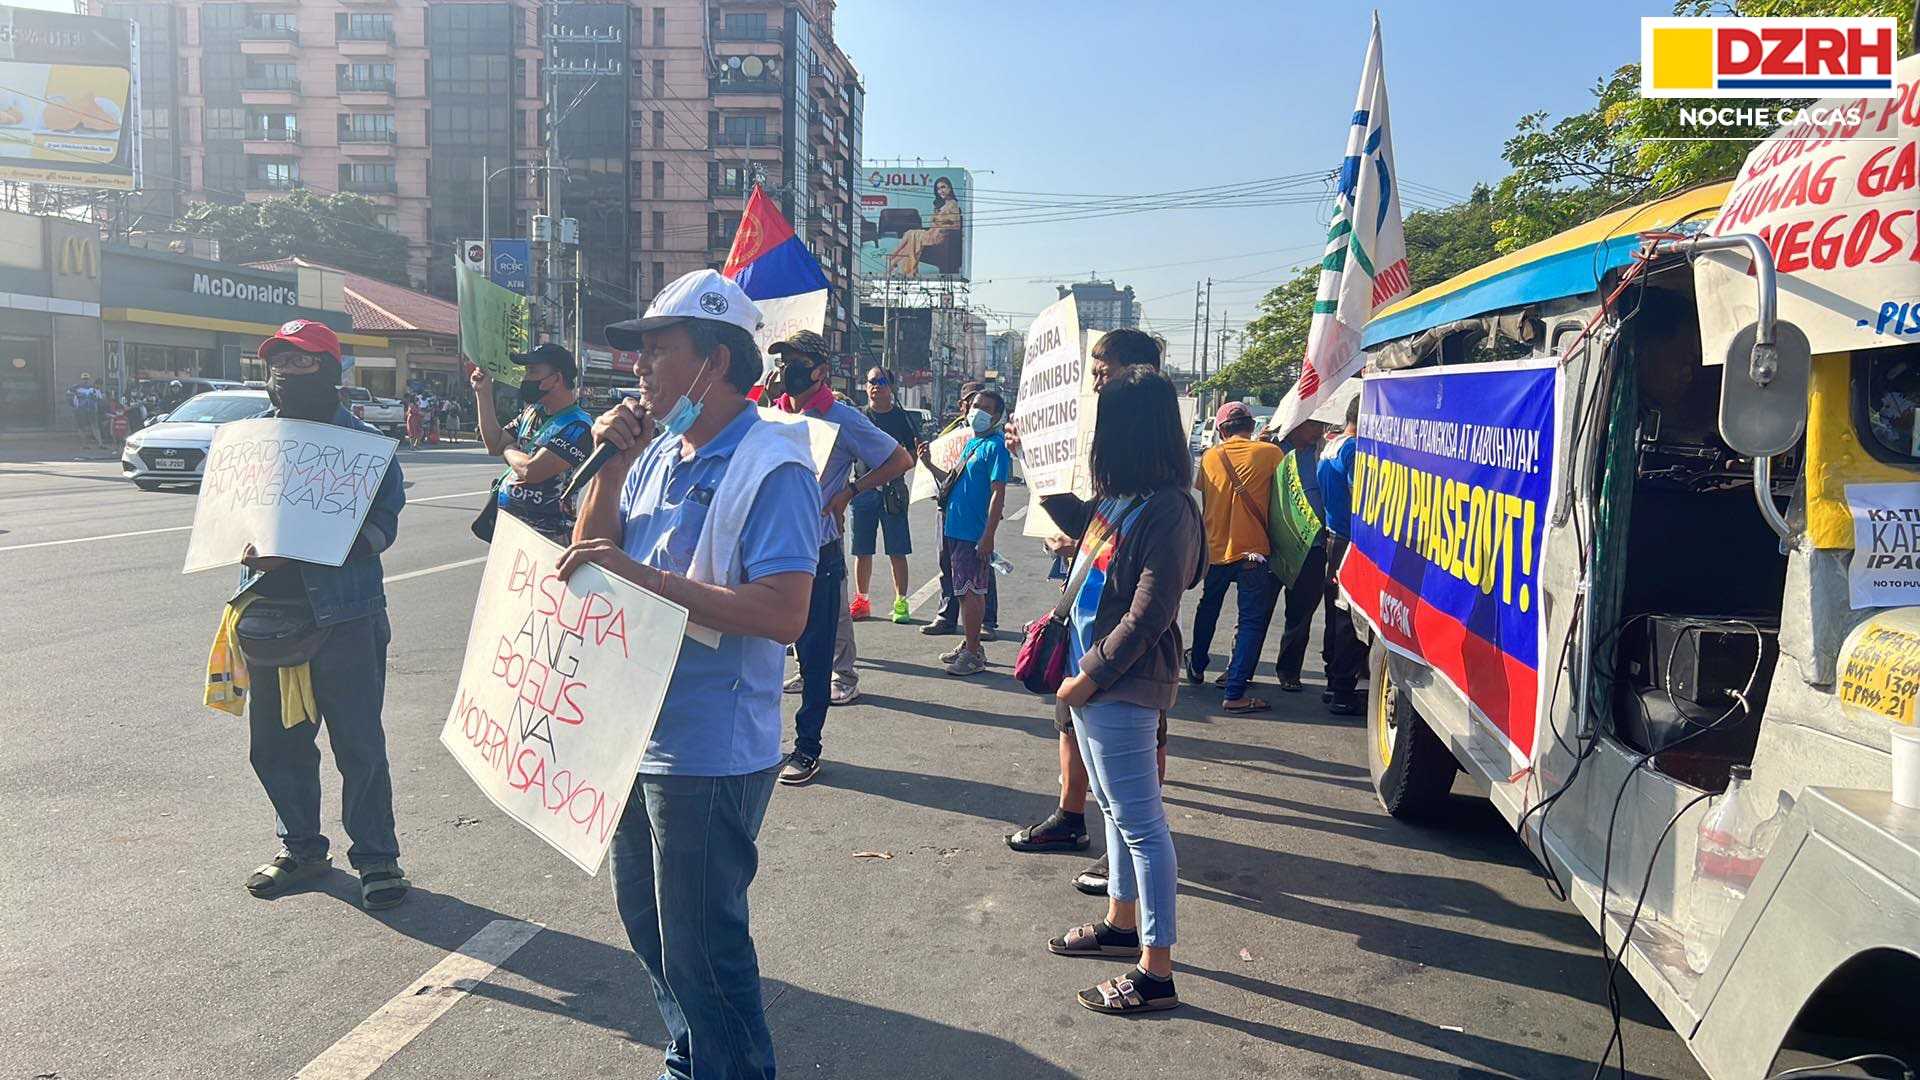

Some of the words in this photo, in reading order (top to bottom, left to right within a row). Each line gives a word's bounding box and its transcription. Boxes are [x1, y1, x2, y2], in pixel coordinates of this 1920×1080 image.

[885, 174, 929, 186] JOLLY
[1715, 156, 1845, 236] HUWAG
[193, 273, 296, 306] McDonald's
[1030, 360, 1080, 397] OMNIBUS
[1016, 398, 1077, 436] RANCHIZING
[569, 446, 586, 462] OPS
[1457, 424, 1473, 462] AT
[511, 485, 543, 504] OPS
[1374, 459, 1409, 543] PUV
[1405, 467, 1536, 613] PHASEOUT!
[508, 549, 629, 658] BASURA
[514, 609, 584, 678] ANG
[492, 634, 588, 725] BOGUS
[1885, 695, 1906, 719] 21
[505, 697, 556, 764] NA
